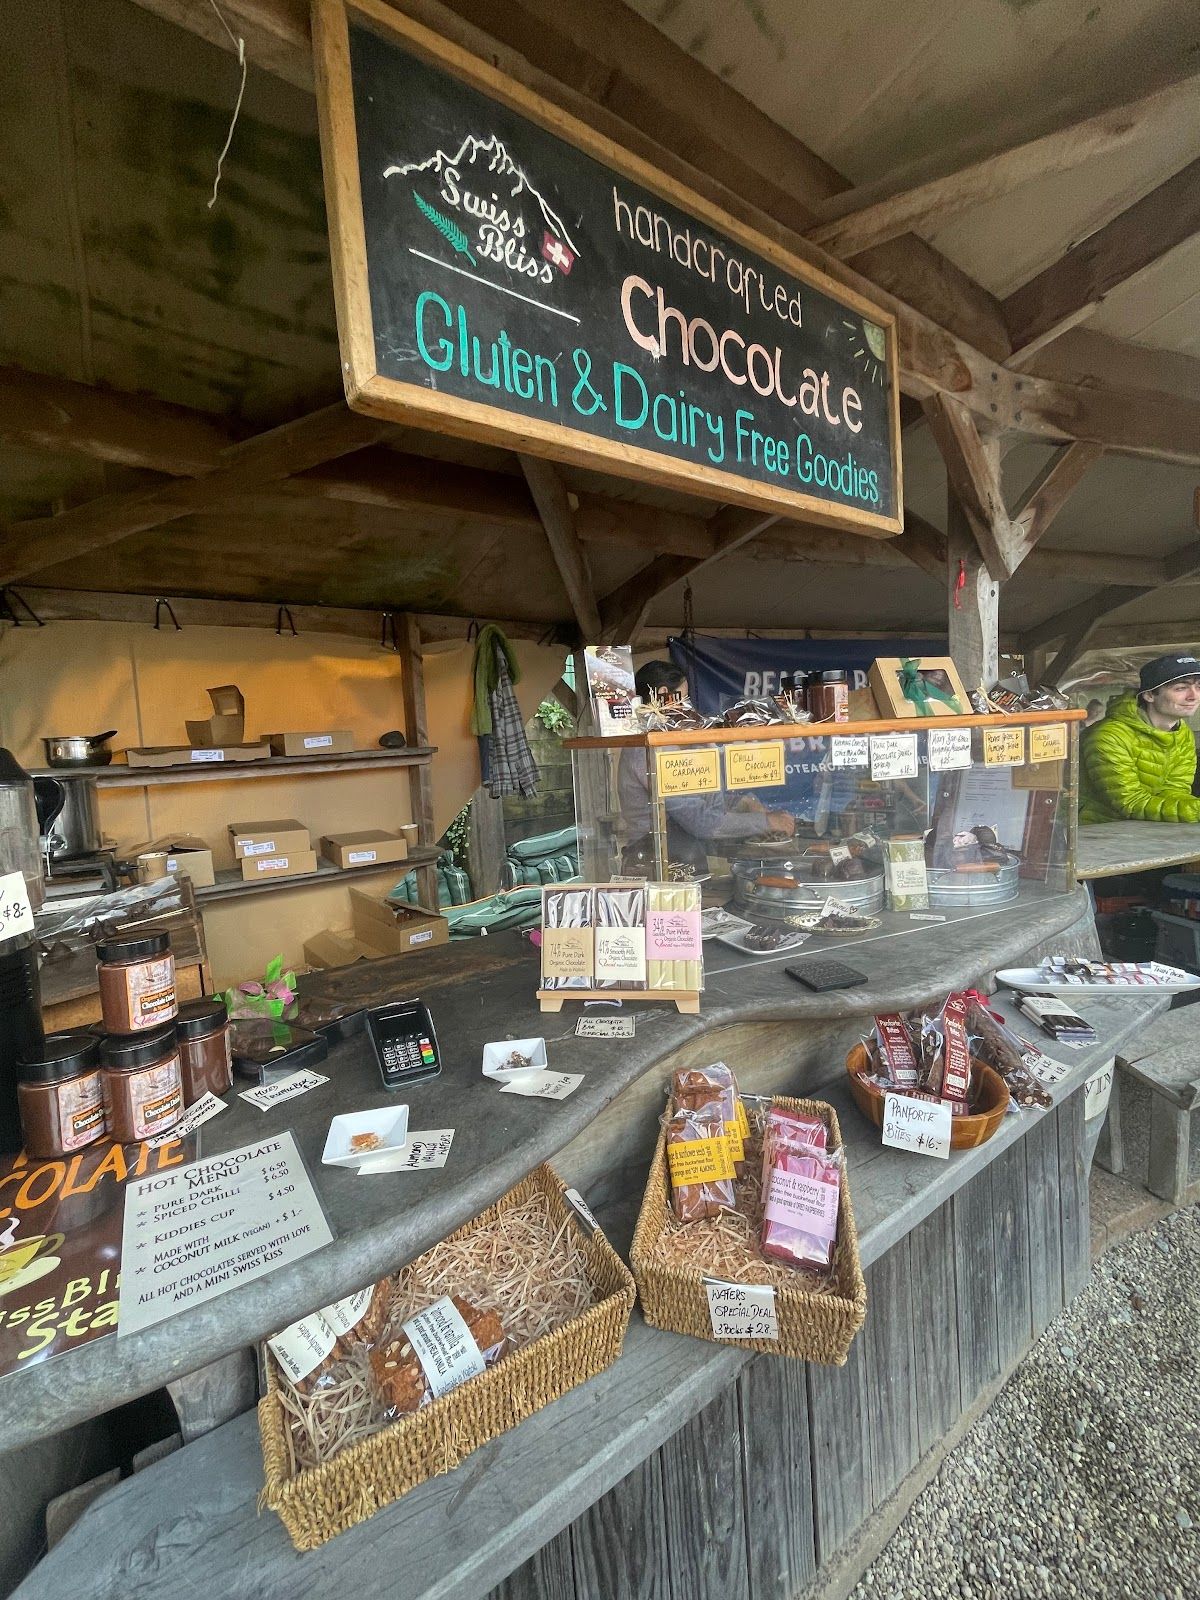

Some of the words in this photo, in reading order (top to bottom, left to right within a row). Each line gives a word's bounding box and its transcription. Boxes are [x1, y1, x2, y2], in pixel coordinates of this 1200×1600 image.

[440, 166, 526, 237] Swiss
[476, 223, 553, 283] Bliss
[612, 186, 803, 328] handcrafted
[415, 291, 559, 408] Gluten
[571, 348, 608, 416] &
[613, 361, 725, 464] Dairy
[735, 410, 790, 477] Free
[796, 433, 879, 503] Goodies
[665, 758, 693, 770] ORANGE
[732, 753, 754, 763] CHILLI
[745, 760, 777, 771] CHOCOLATE
[549, 959, 565, 967] Organic
[562, 951, 573, 959] Pure
[573, 951, 585, 959] Dark
[142, 997, 166, 1009] Chocolate
[879, 1018, 902, 1027] Panforte
[886, 1026, 900, 1034] Bites
[945, 1016, 963, 1030] Panforte
[74, 1112, 99, 1129] Chocolate
[145, 1104, 170, 1118] Chocolate
[888, 1097, 939, 1122] PANFORTE
[884, 1121, 911, 1142] BITES
[138, 1175, 179, 1196] HOT
[183, 1141, 281, 1180] CHOCOLATE
[188, 1165, 240, 1190] MENU
[154, 1196, 185, 1213] PURE
[189, 1184, 223, 1201] DARK
[269, 1160, 287, 1172] 6.50
[771, 1175, 792, 1189] coconut
[791, 1178, 797, 1190] &
[153, 1203, 198, 1223] SPICED
[201, 1187, 241, 1206] CHILLI
[271, 1168, 290, 1180] 6.50
[783, 1189, 792, 1198] free
[815, 1199, 826, 1208] flour
[154, 1219, 207, 1245] KIDDIES
[210, 1208, 236, 1223] CUP
[275, 1184, 295, 1198] 4.50
[153, 1244, 211, 1274] COCONUT
[213, 1232, 241, 1250] MILK
[242, 1221, 272, 1239] (VEGAN)
[153, 1248, 183, 1264] MADE
[184, 1235, 210, 1251] WITH
[138, 1290, 156, 1305] ALL
[157, 1281, 178, 1297] HOT
[179, 1257, 237, 1288] CHOCOLATES
[236, 1243, 267, 1264] SERVED
[267, 1233, 291, 1250] WITH
[291, 1223, 311, 1239] LOVE
[172, 1286, 195, 1302] AND
[195, 1283, 203, 1293] A
[204, 1272, 231, 1289] MINI
[232, 1258, 262, 1277] SWISS
[263, 1248, 284, 1264] KISS
[714, 1302, 751, 1318] SPECIAL
[750, 1303, 776, 1321] DEAL
[430, 1305, 453, 1329] almond
[443, 1330, 465, 1350] vanilla
[434, 1354, 448, 1377] VANILLA
